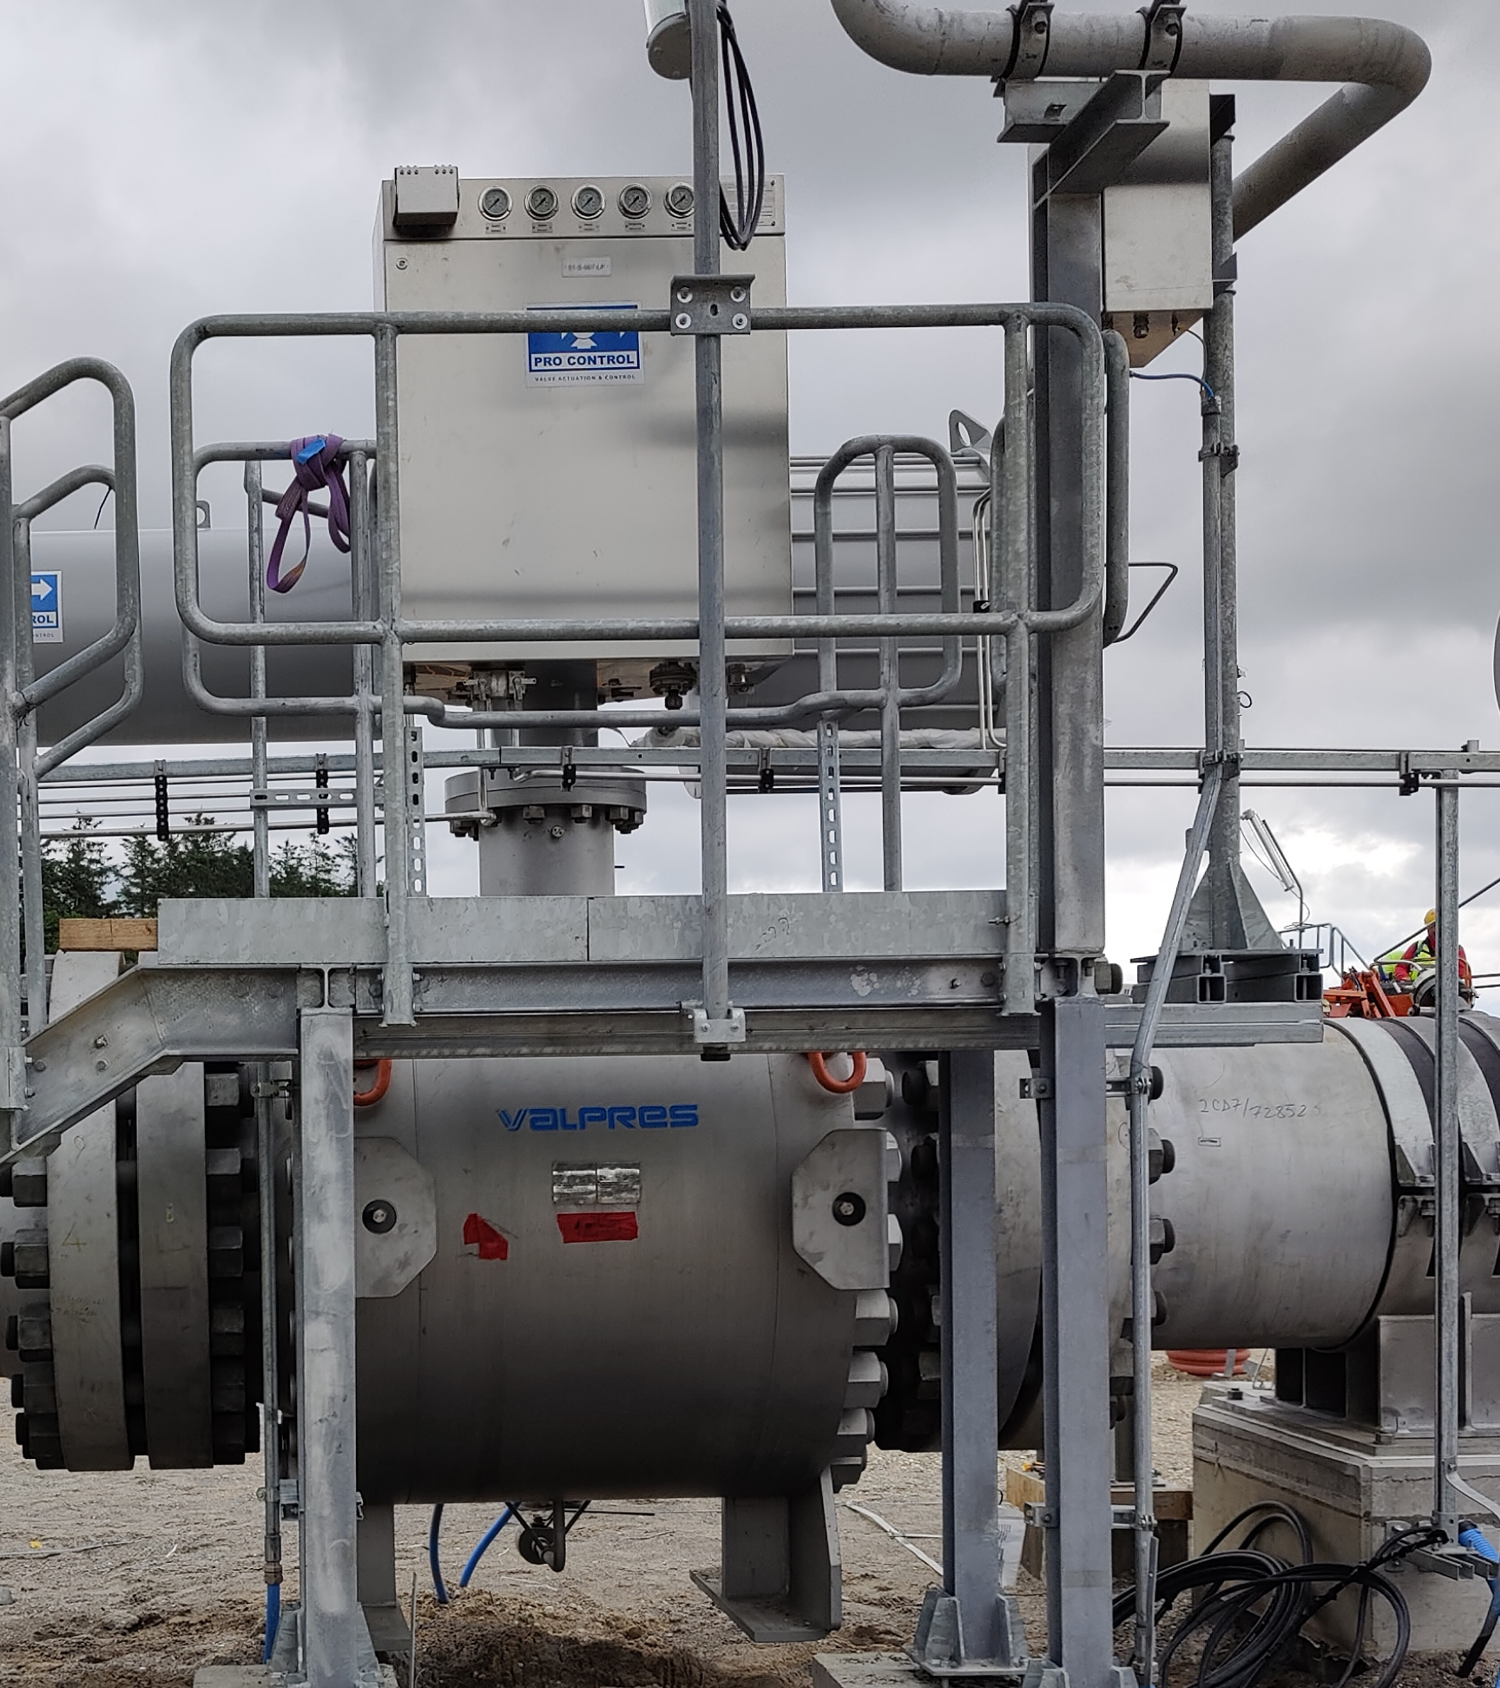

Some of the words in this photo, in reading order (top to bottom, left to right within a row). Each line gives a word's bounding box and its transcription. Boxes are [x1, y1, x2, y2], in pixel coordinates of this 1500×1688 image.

[534, 356, 562, 367] PRO
[567, 354, 635, 366] CONTROL
[558, 374, 596, 382] ACTUATION
